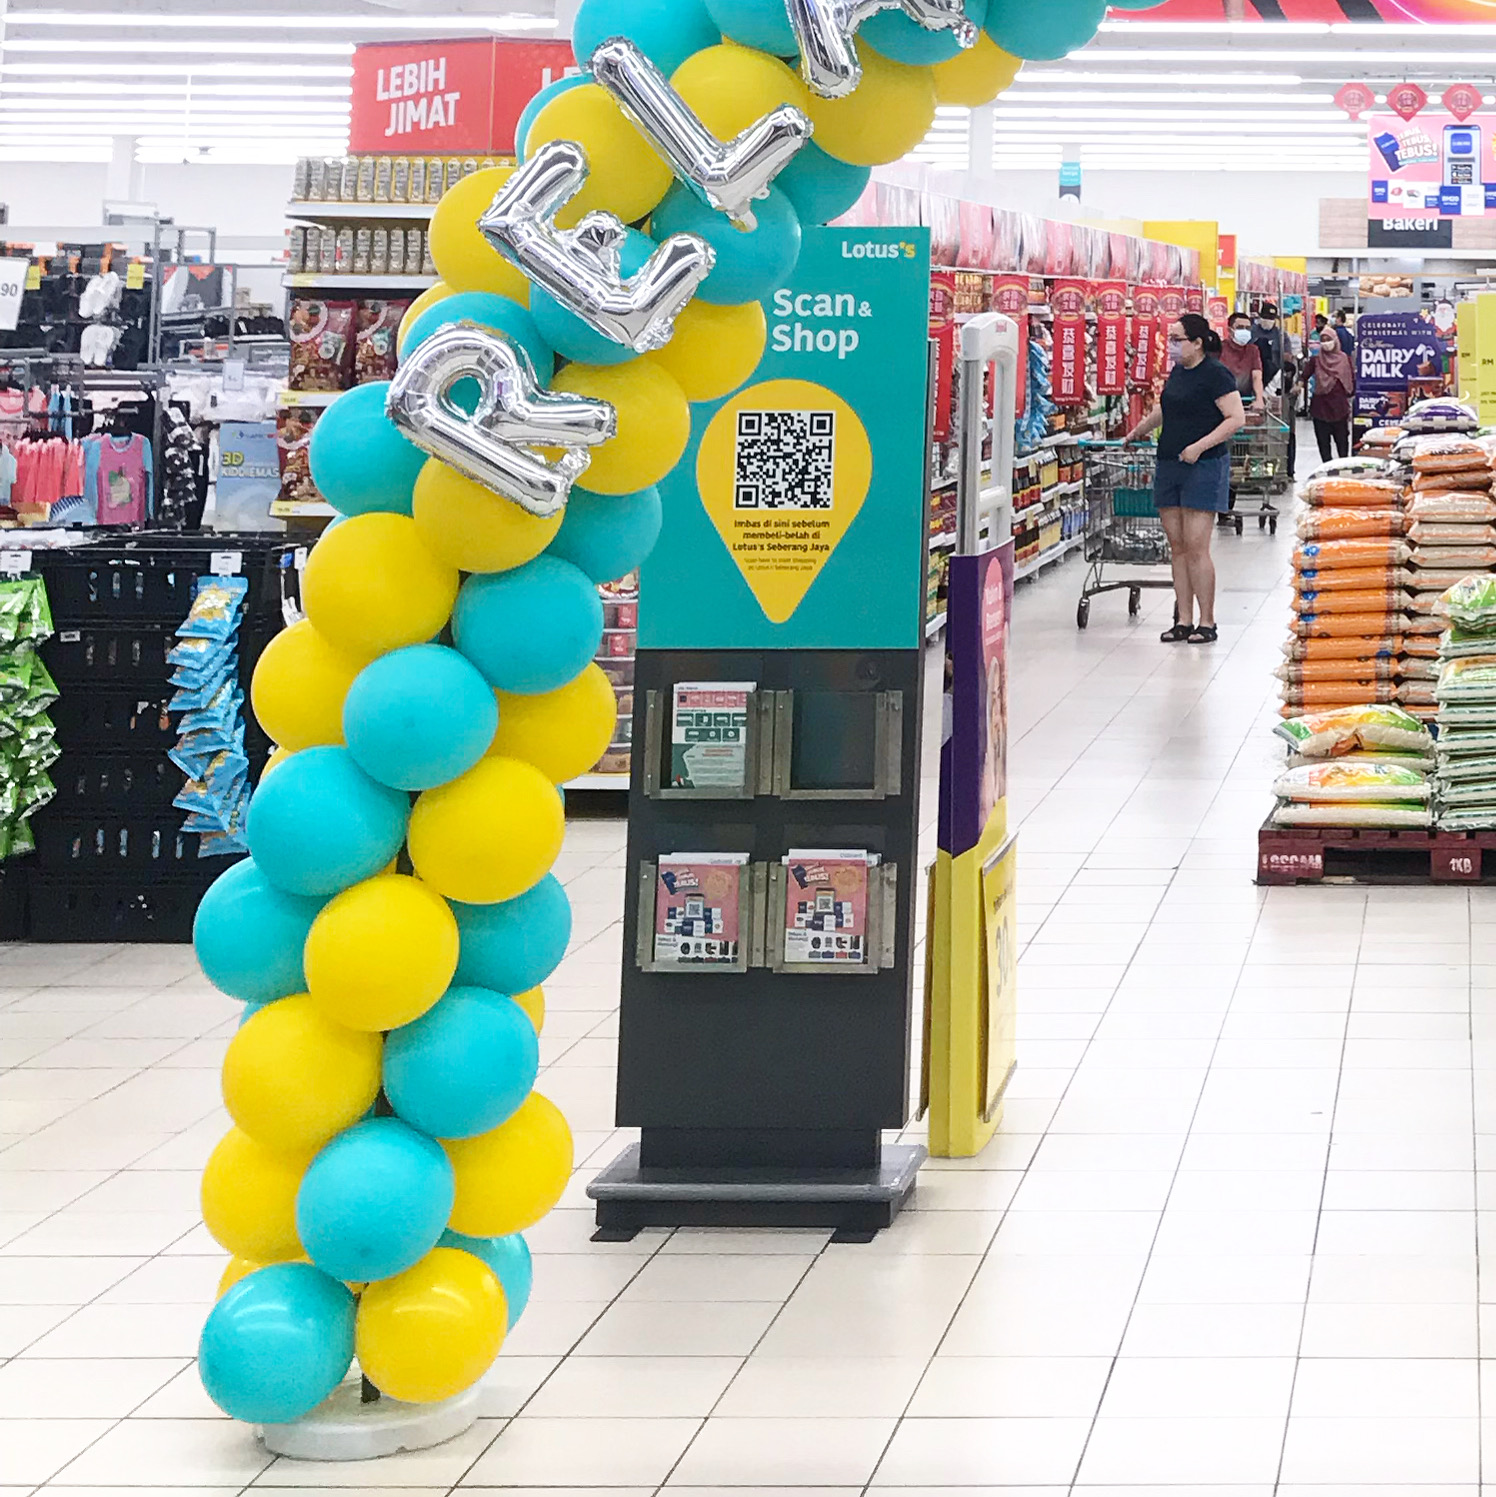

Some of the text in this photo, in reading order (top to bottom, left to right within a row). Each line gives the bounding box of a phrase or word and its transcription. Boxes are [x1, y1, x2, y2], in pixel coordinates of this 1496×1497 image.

[376, 57, 447, 102] LEBIH
[384, 91, 461, 137] JIMAT
[1394, 143, 1438, 160] TEBUS!
[841, 239, 916, 260] Lotus's
[772, 288, 872, 318] Scan &
[771, 323, 860, 361] Shop
[1361, 348, 1414, 363] DAIRY
[1482, 358, 1494, 366] RM
[1361, 363, 1404, 378] MILK
[222, 452, 243, 466] 3D
[734, 519, 830, 529] Imbas di sini sebelum
[742, 530, 820, 540] membeli-belah di
[766, 542, 808, 553] Seberang
[810, 542, 830, 553] Jaya
